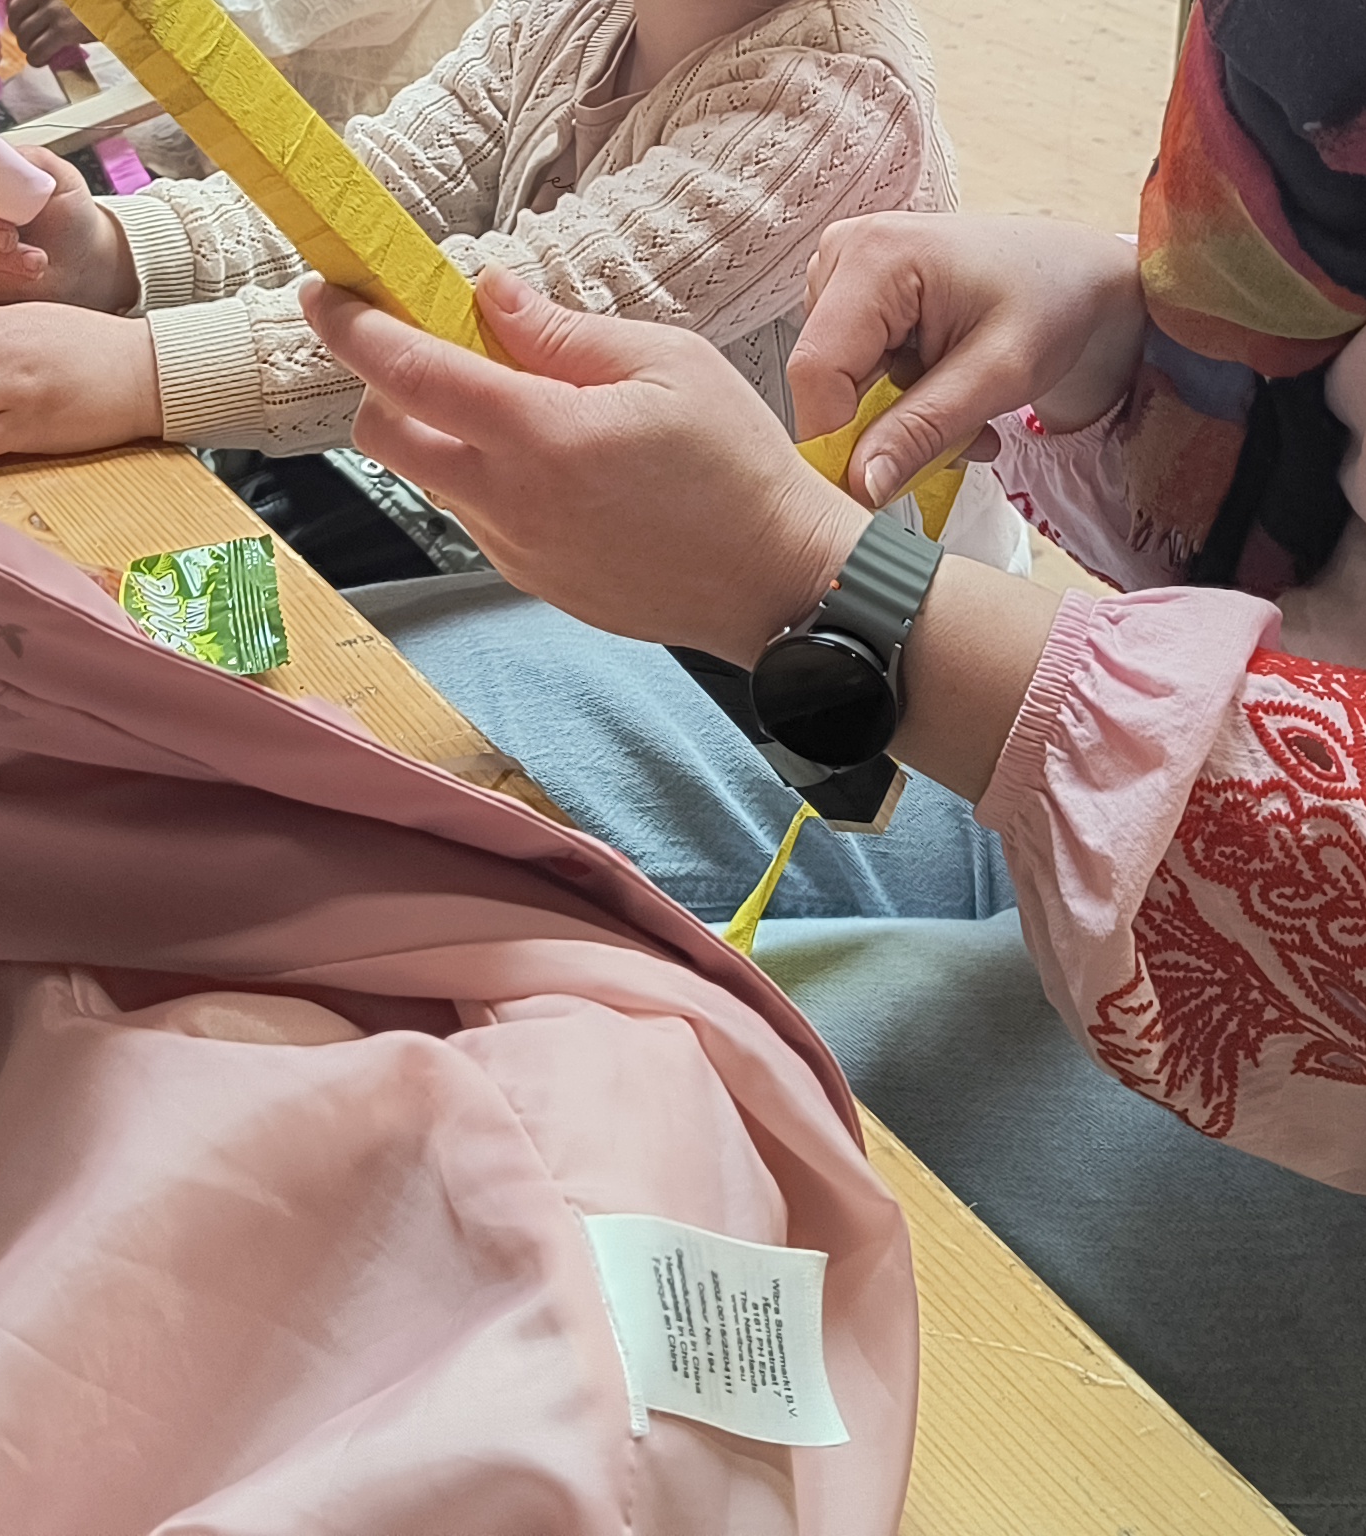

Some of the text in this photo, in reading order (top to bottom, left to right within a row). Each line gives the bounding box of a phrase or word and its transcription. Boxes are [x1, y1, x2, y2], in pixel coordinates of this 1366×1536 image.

[185, 597, 209, 632] MINI
[743, 1317, 758, 1393] Netherlands
[775, 1318, 792, 1391] Supermarkt
